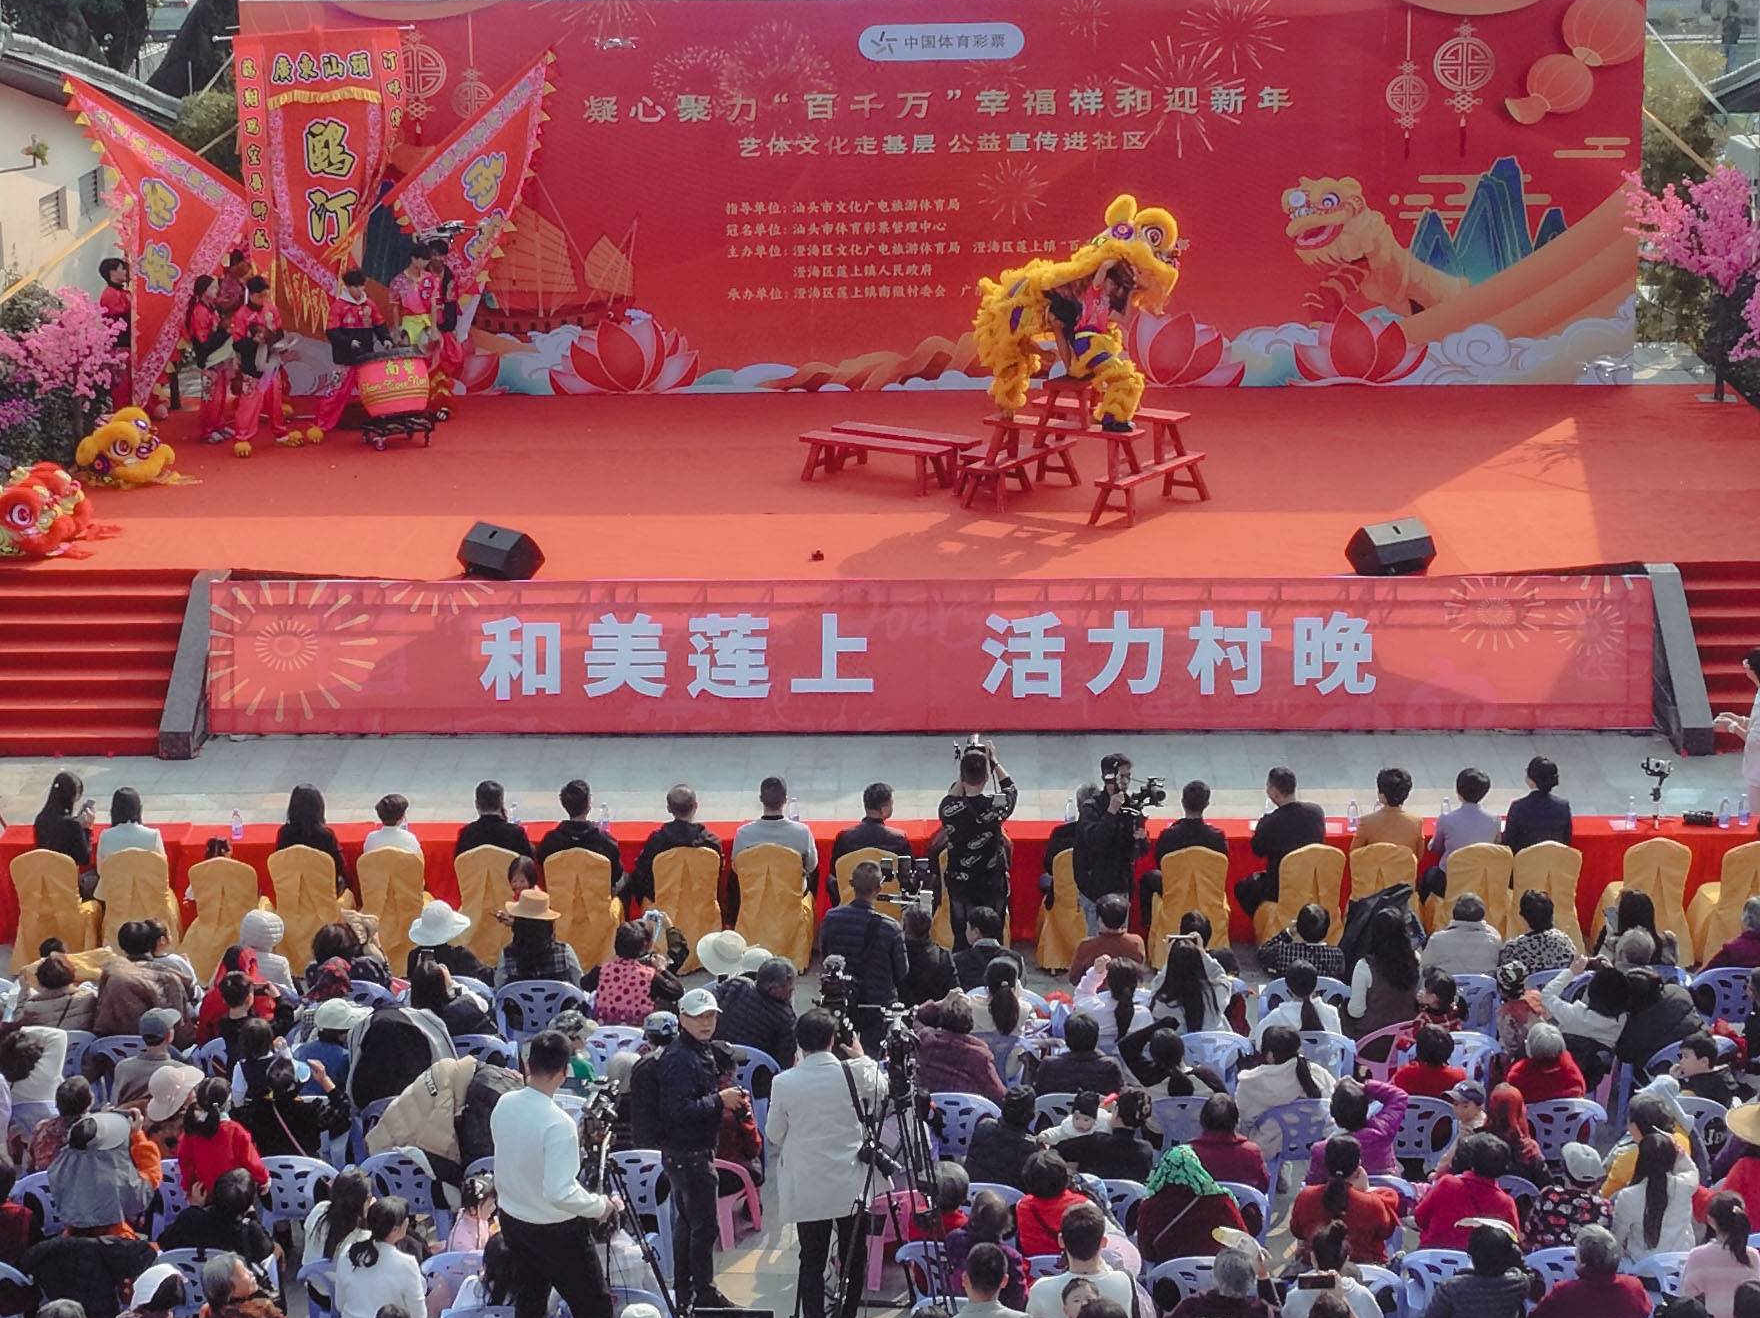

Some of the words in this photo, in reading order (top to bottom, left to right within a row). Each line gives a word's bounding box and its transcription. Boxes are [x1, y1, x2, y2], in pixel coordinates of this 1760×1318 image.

[904, 33, 1006, 49] 中国体育彩票
[272, 50, 372, 83] 廣東汕頭
[738, 134, 936, 158] 艺体文化走基层
[948, 131, 1147, 154] 公益宣传进社区
[792, 263, 933, 279] 澄海区莲上镇人民政府
[480, 612, 875, 700] 和美莲上
[983, 610, 1378, 699] 活力村晚
